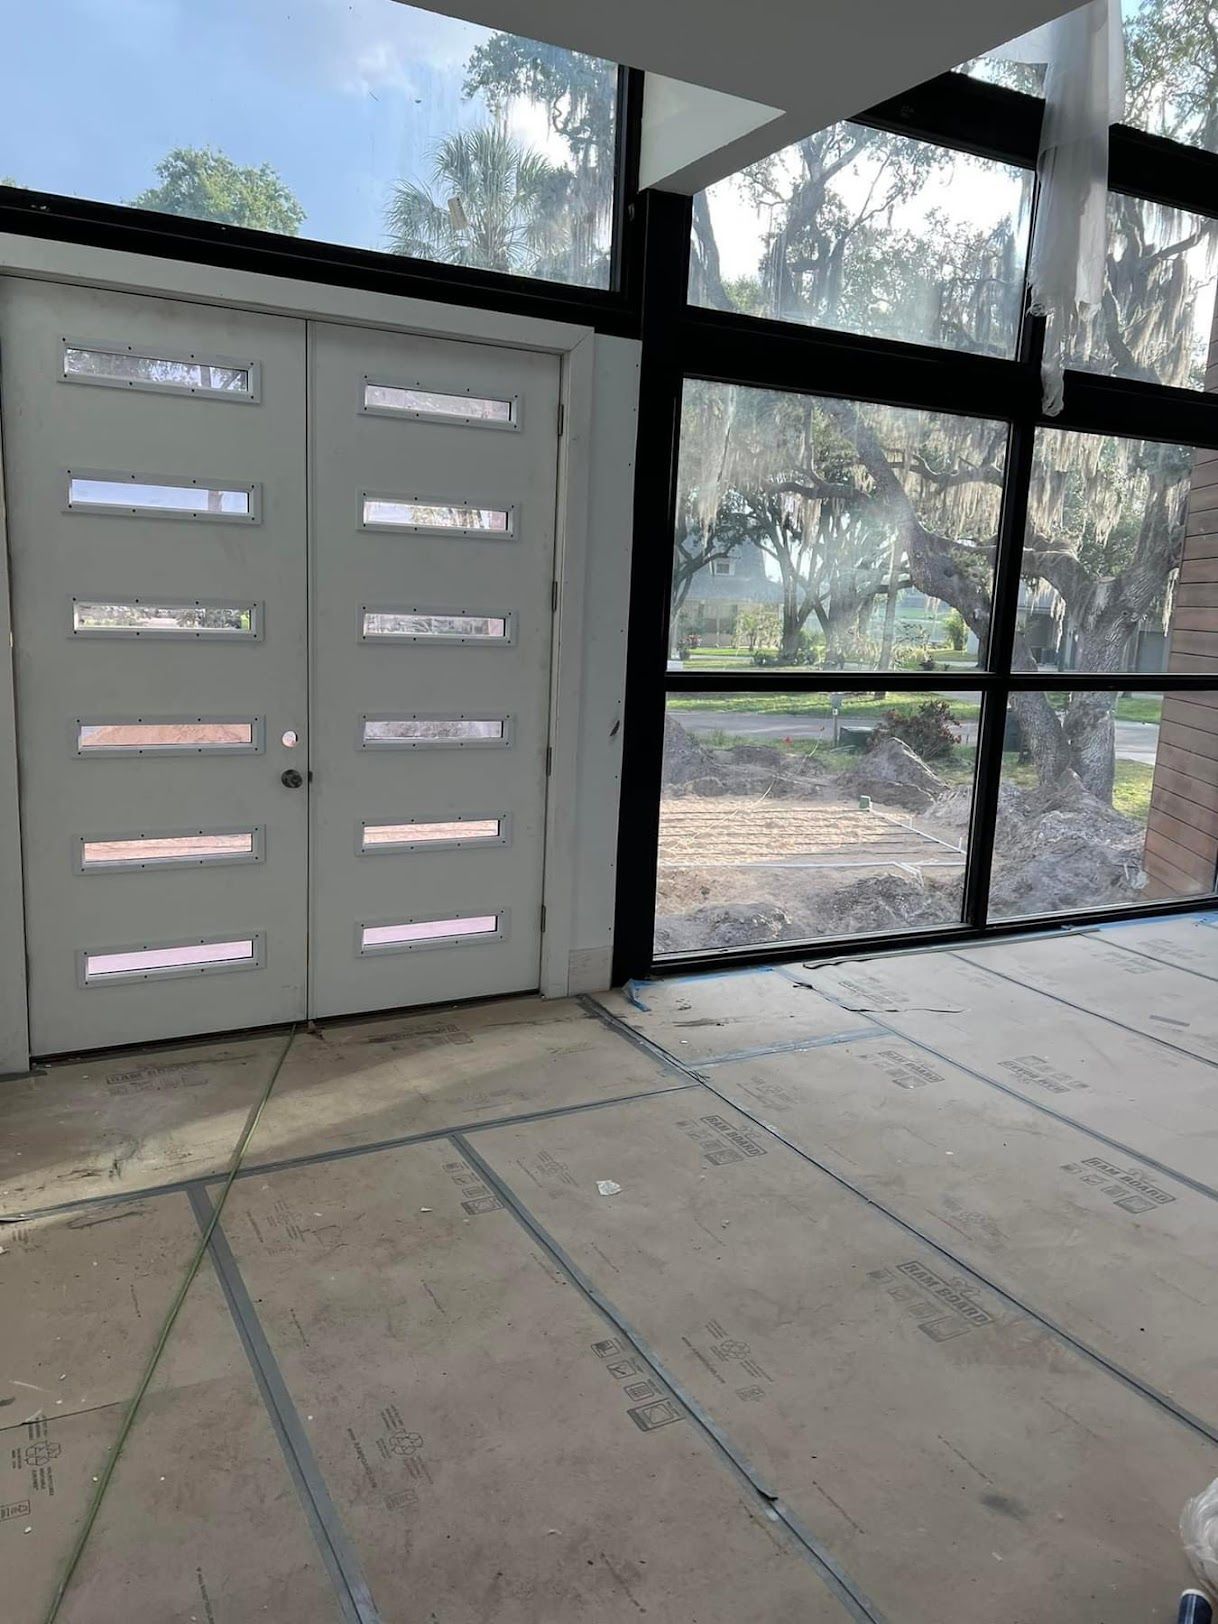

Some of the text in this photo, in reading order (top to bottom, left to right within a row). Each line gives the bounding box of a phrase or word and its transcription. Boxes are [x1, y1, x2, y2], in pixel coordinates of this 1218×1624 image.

[706, 1116, 760, 1155] RAM BOARD
[1087, 1160, 1168, 1201] RAM BOARD
[904, 1264, 990, 1323] RAM BOARD
